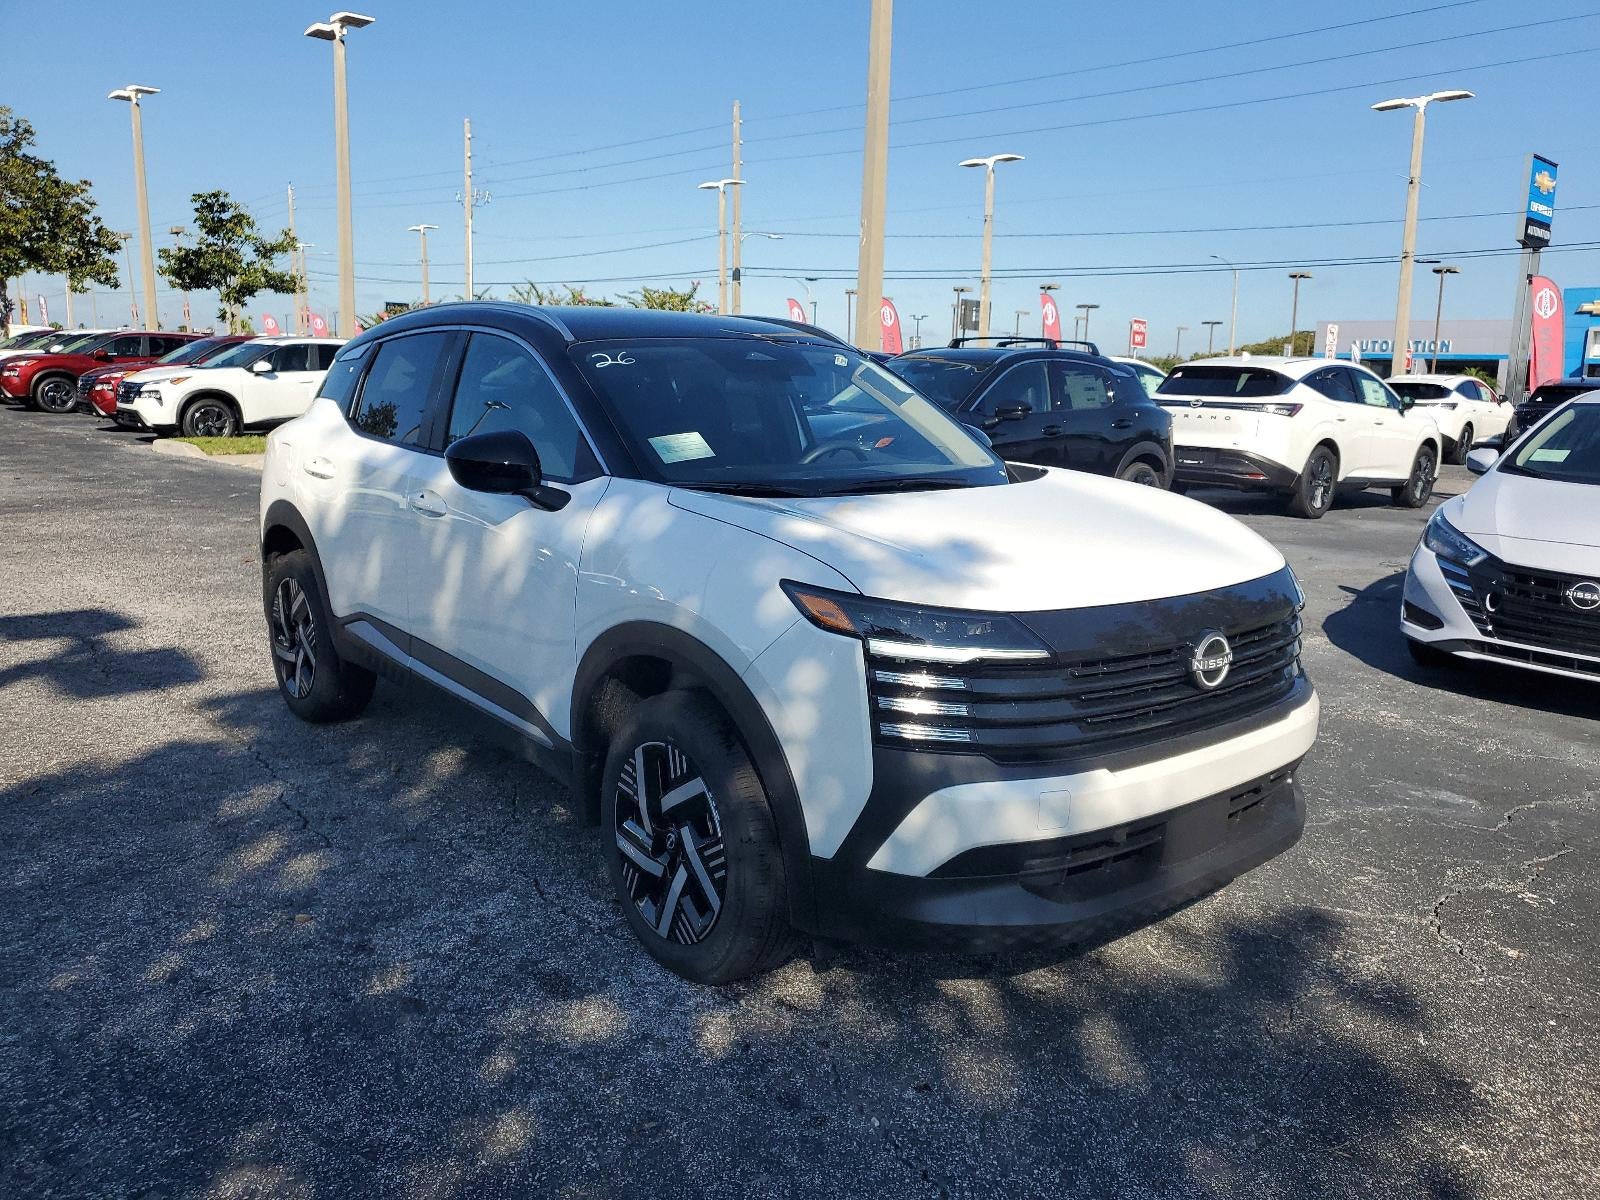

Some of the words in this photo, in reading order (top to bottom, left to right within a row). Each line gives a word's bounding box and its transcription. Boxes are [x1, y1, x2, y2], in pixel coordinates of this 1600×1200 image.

[591, 351, 636, 368] 26
[1172, 413, 1231, 421] URANO
[1565, 590, 1600, 601] NISSA
[1193, 652, 1233, 670] NISSAN
